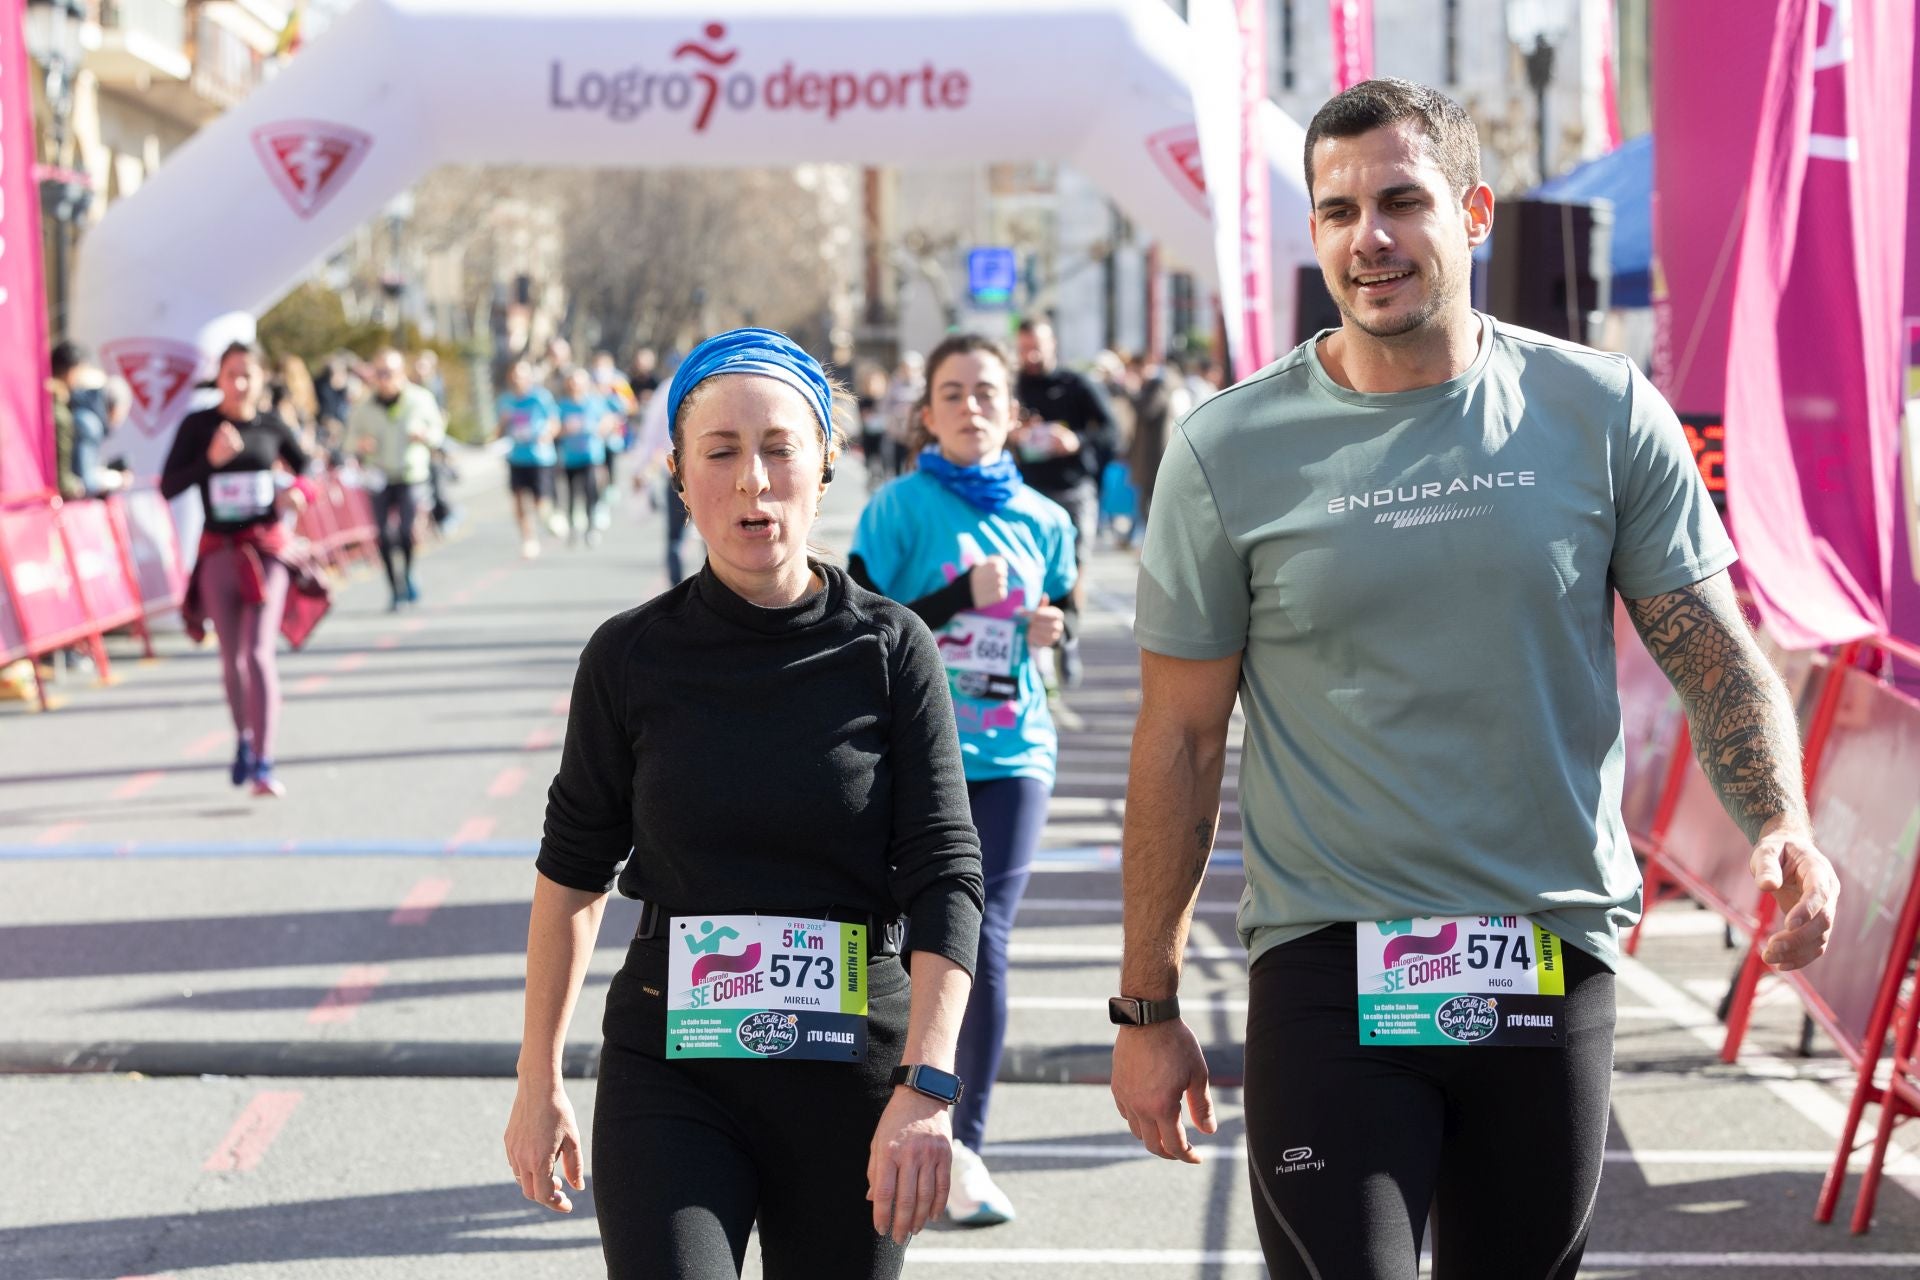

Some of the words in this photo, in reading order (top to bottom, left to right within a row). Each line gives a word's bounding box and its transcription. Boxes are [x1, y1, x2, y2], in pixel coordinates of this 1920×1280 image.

[763, 61, 971, 121] deporte
[1328, 471, 1535, 514] ENDURANCE
[782, 929, 824, 950] 5Km
[848, 941, 858, 955] FIZ
[1467, 934, 1531, 970] 574
[1540, 932, 1554, 971] MARTÍN
[769, 954, 835, 990] 573
[847, 956, 858, 992] MARTÍN
[1384, 968, 1405, 993] SE
[1408, 952, 1462, 986] CORRE
[1488, 978, 1513, 987] HUGO
[691, 985, 711, 1008] SE
[713, 971, 764, 1002] CORRE
[784, 996, 820, 1006] MIRELLA
[1440, 1009, 1466, 1028] San
[1466, 1008, 1493, 1030] Juan
[1507, 1015, 1523, 1027] ¡TU
[1524, 1015, 1553, 1027] CALLE!
[741, 1024, 766, 1041] San
[766, 1024, 793, 1044] Juan
[807, 1031, 823, 1042] ¡TU
[825, 1032, 854, 1044] CALLE!
[1276, 1159, 1325, 1175] Kalenji
